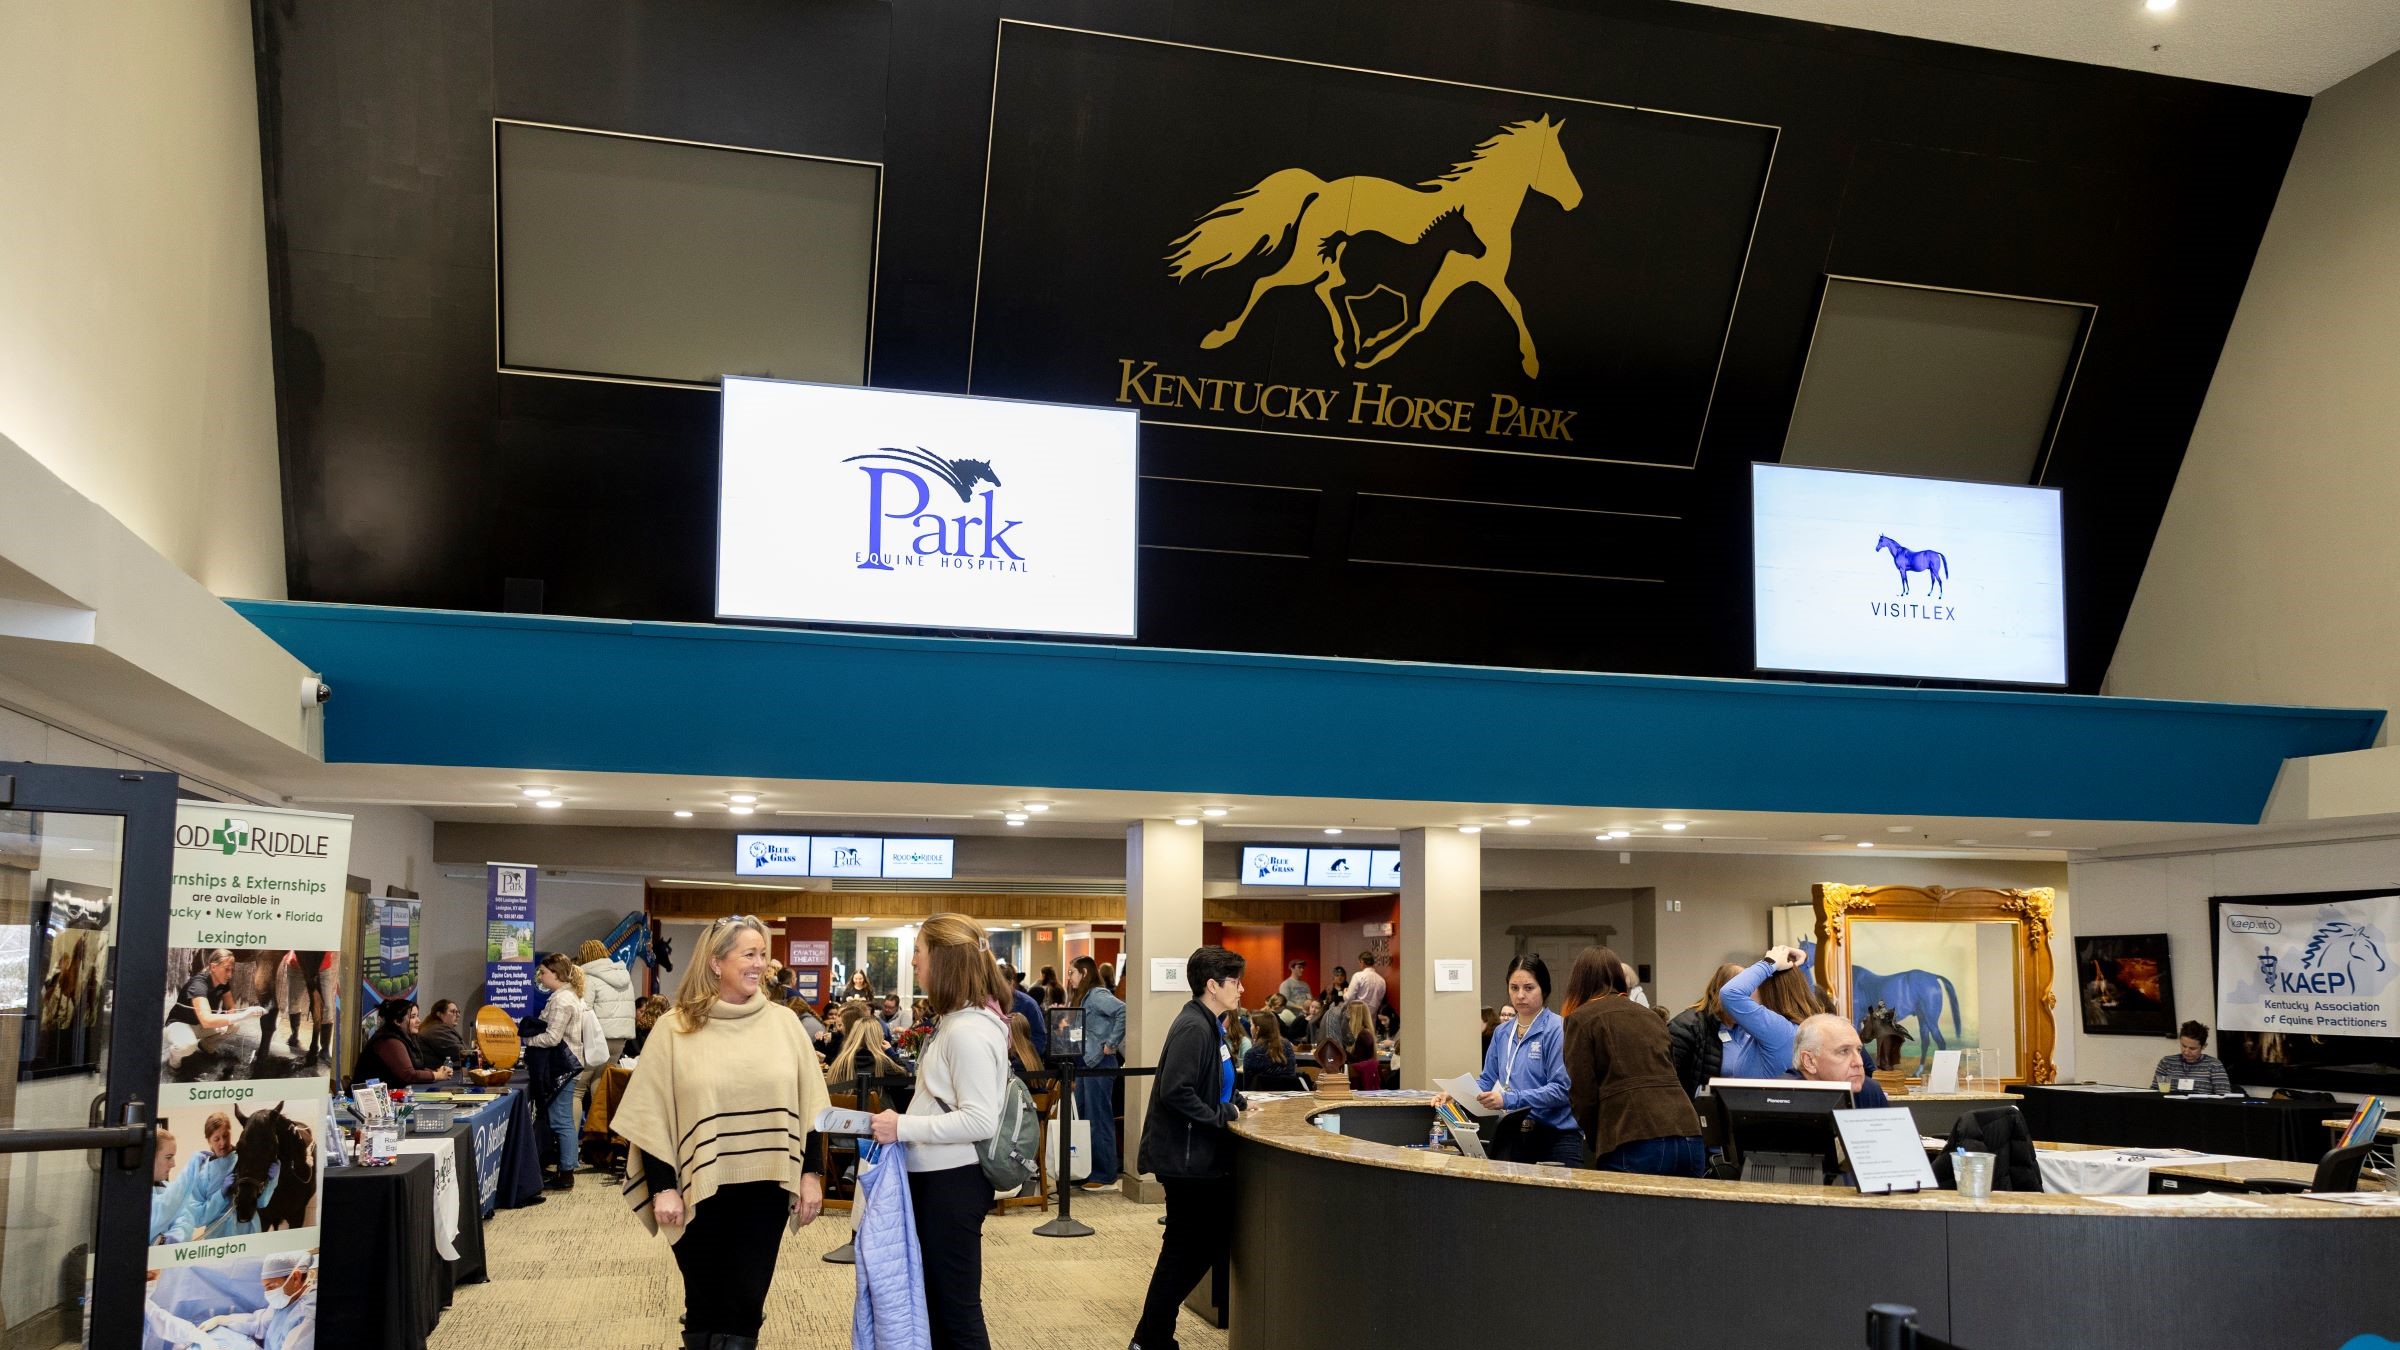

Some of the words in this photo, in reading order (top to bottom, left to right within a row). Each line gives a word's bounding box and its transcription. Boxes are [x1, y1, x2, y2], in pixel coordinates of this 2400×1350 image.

[1115, 358, 1339, 421] KENTUCKY
[1348, 382, 1475, 434] HORSE
[1486, 393, 1579, 442] PARK
[859, 466, 1025, 571] Park
[855, 551, 925, 567] EQUINE
[941, 557, 1029, 573] HOSPITAL
[1871, 601, 1955, 621] VISITLEX
[176, 824, 210, 847] OD
[251, 827, 329, 857] RIDDLE
[832, 850, 861, 868] Park
[172, 872, 227, 890] rnships
[232, 876, 241, 888] &
[247, 876, 327, 895] Externships
[502, 874, 524, 893] Park
[192, 893, 212, 902] are
[216, 893, 267, 905] available
[271, 895, 280, 905] in
[170, 906, 202, 920] ucky
[216, 908, 242, 919] New
[247, 909, 273, 921] York
[285, 911, 323, 922] Florida
[2231, 917, 2276, 931] kaep.info
[198, 930, 267, 947] Lexington
[2280, 972, 2345, 994] KAEP
[2264, 1000, 2309, 1012] Kentucky
[2314, 1002, 2380, 1012] Association
[2264, 1014, 2275, 1024] of
[2279, 1015, 2313, 1026] Equine
[2317, 1016, 2388, 1028] Practitioners
[189, 1086, 254, 1101] Saratoga
[175, 1241, 247, 1262] Wellington
